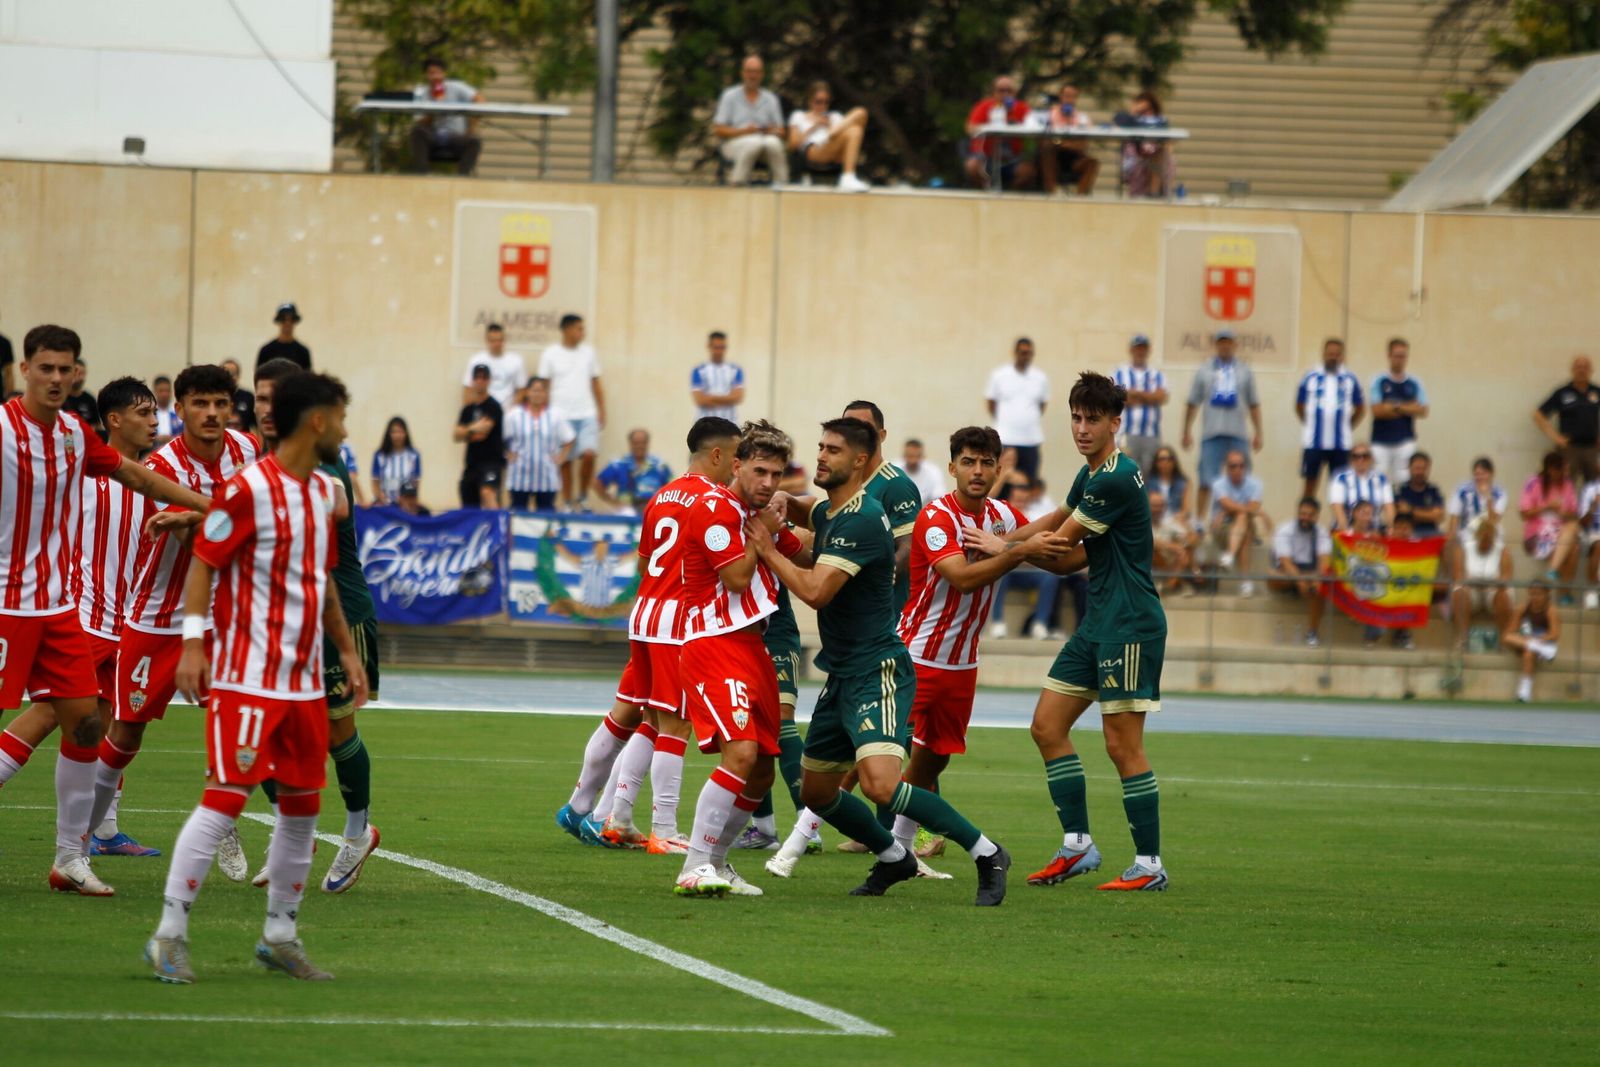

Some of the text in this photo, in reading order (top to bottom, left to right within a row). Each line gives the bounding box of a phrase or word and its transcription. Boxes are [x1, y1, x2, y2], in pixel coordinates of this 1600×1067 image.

[656, 490, 698, 508] AGULLÓ
[648, 517, 679, 577] 2
[131, 656, 151, 689] 4
[724, 678, 749, 709] 15
[238, 706, 265, 748] 11
